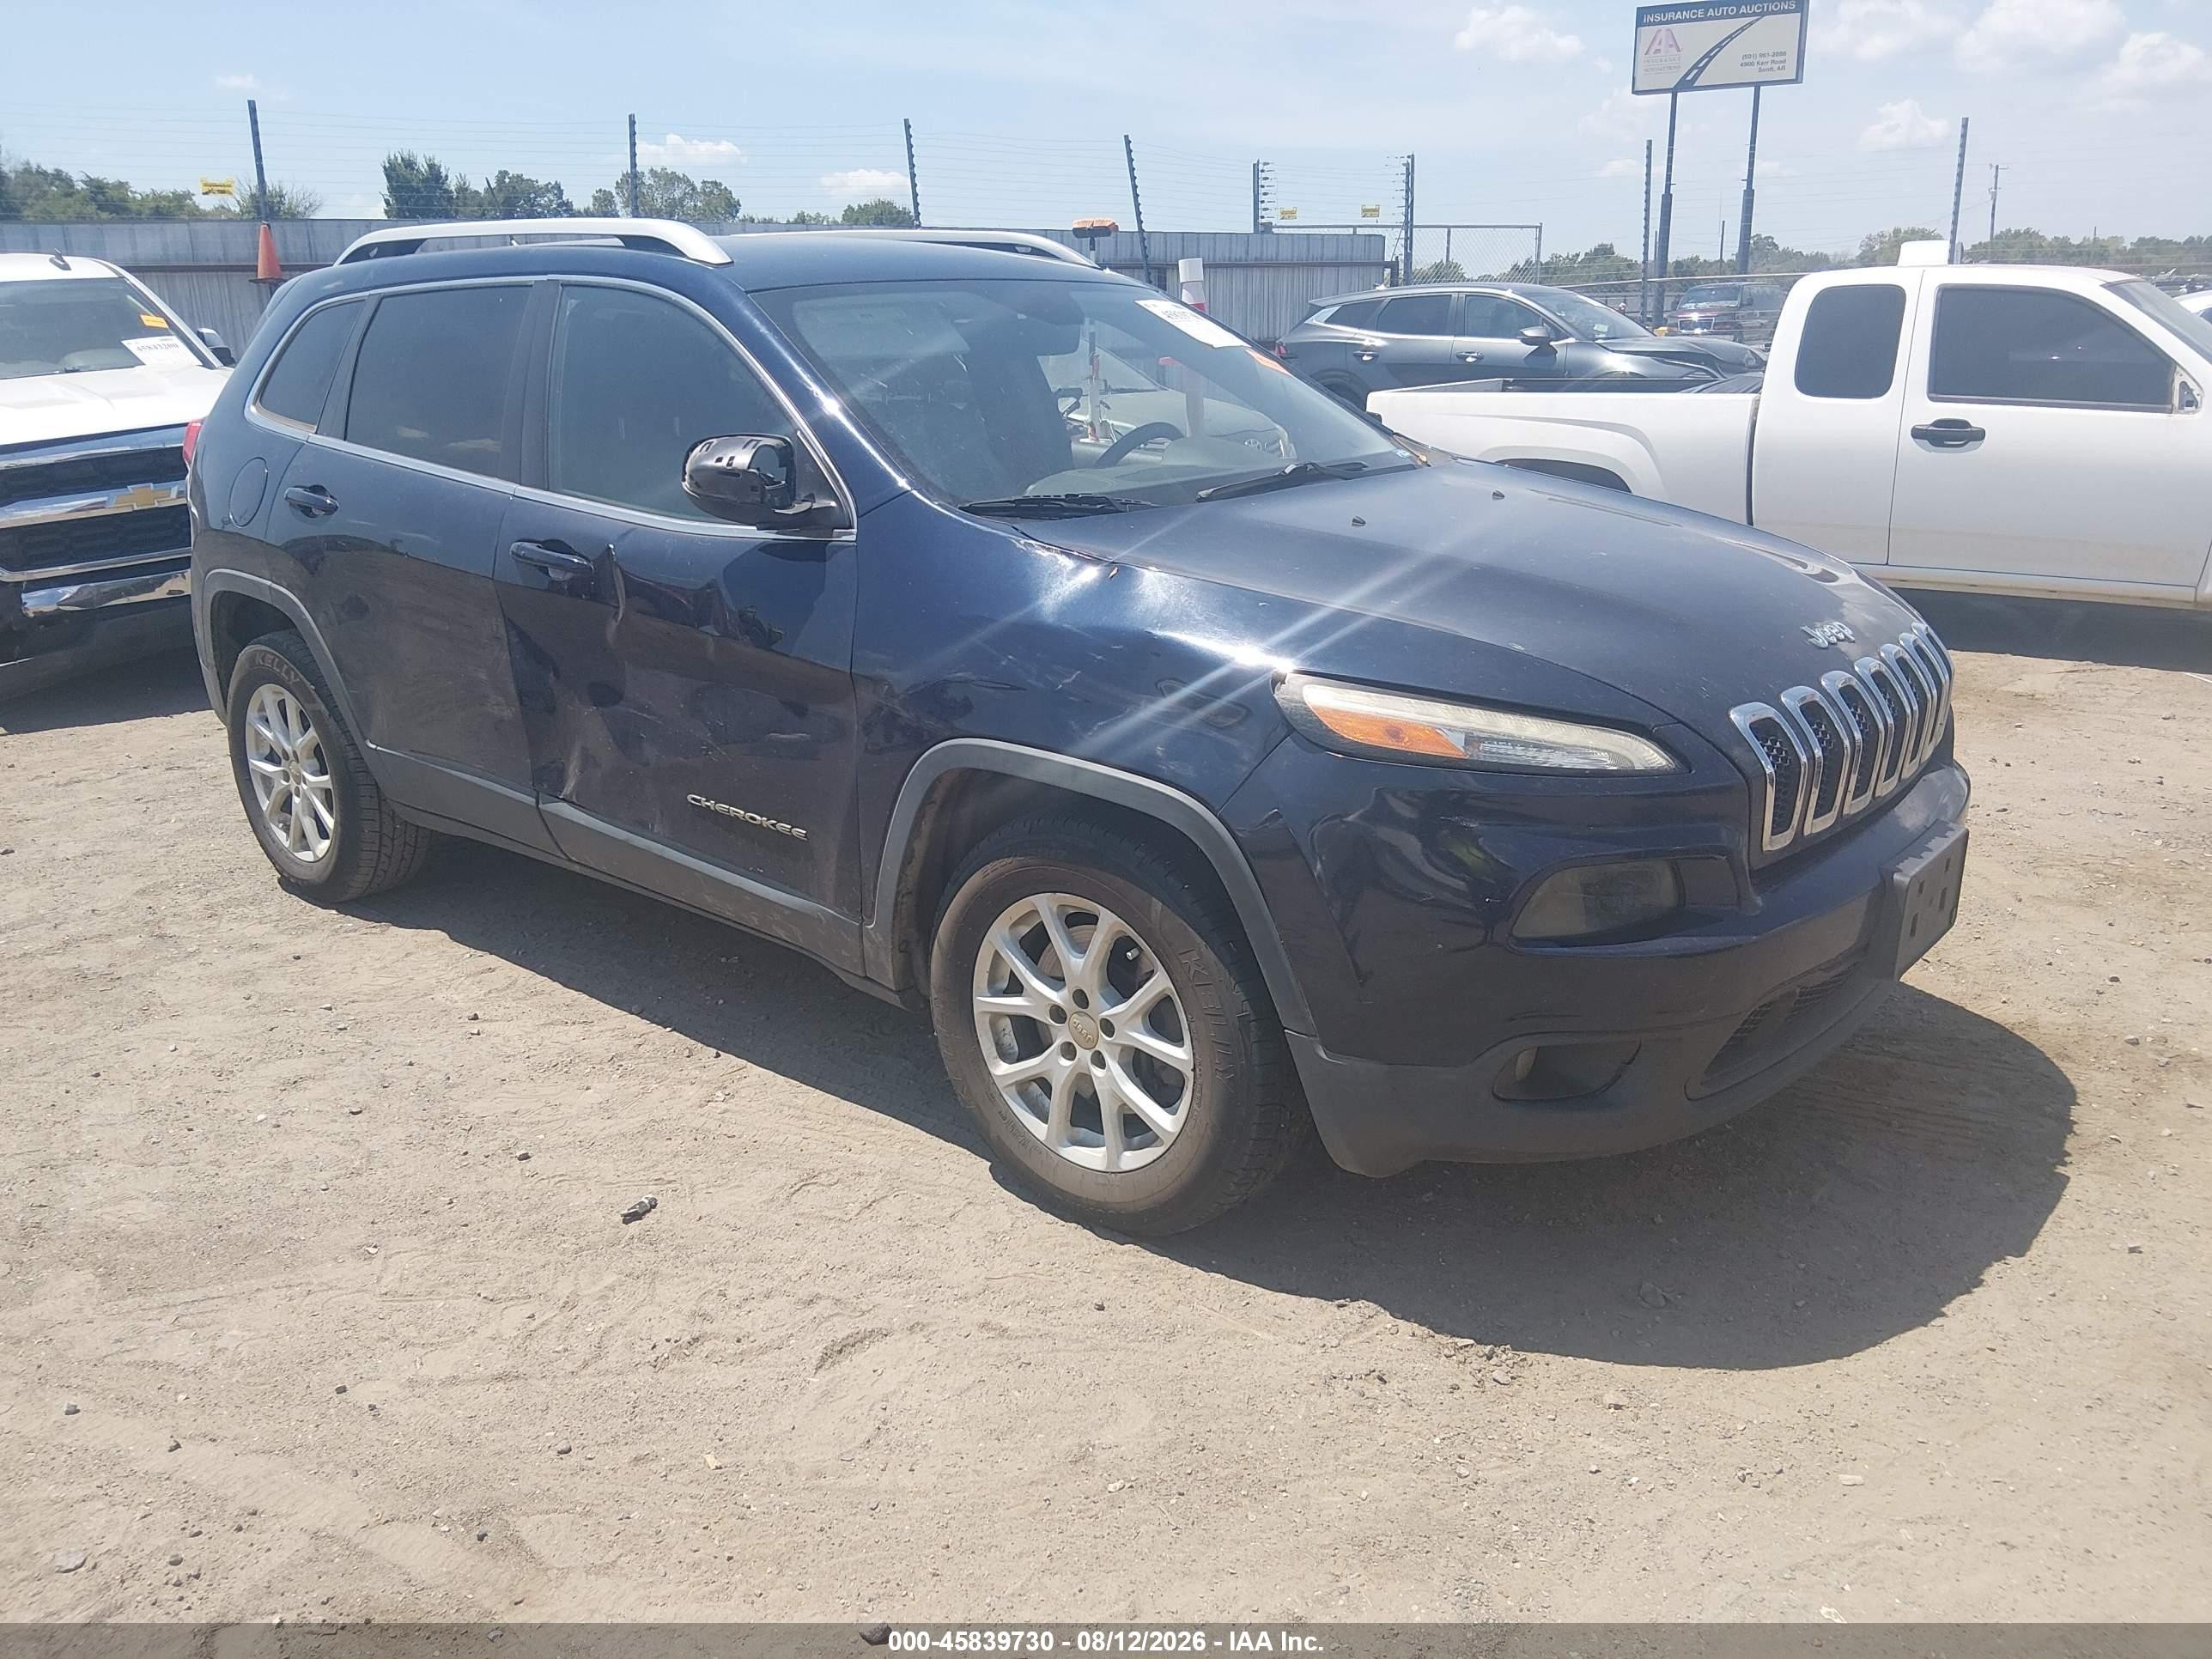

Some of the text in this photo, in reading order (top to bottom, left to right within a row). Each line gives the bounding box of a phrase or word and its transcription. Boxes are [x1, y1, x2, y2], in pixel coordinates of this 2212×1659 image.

[1644, 1, 1796, 24] INSURANCE AUTO AUCTIONS
[1800, 622, 1856, 648] Jeep
[256, 653, 301, 684] KELLY
[687, 794, 807, 841] CHEROKEE
[1177, 949, 1237, 1094] KELLY
